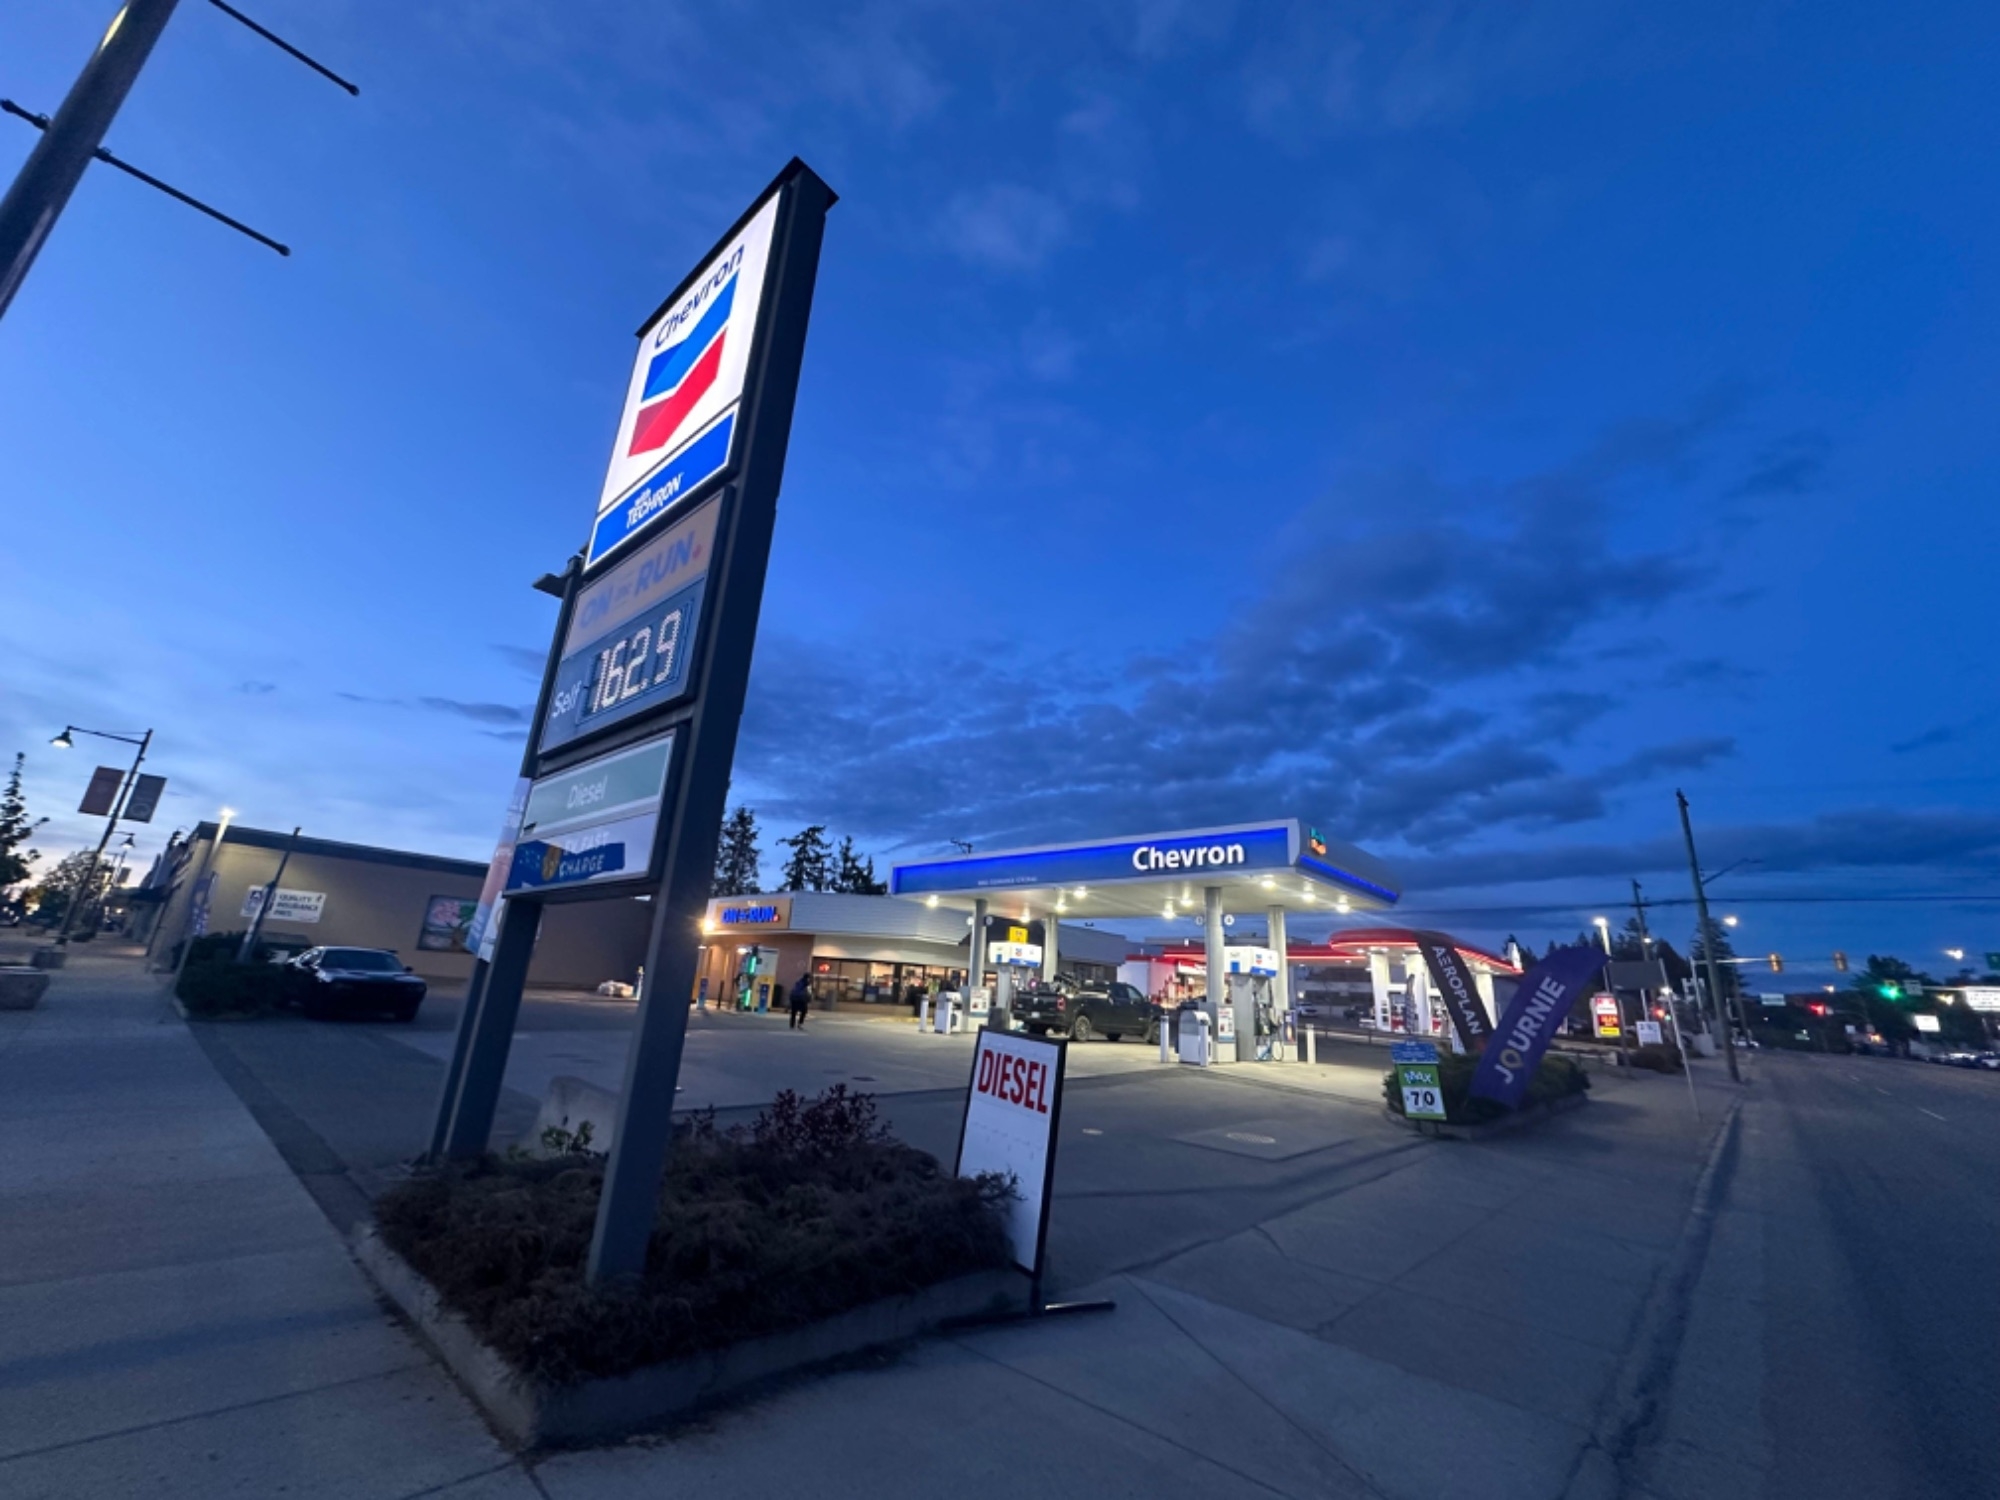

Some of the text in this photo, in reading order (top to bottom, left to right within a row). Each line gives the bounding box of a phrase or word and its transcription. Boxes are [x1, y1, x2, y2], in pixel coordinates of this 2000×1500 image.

[655, 244, 744, 349] Chevron
[626, 474, 682, 529] TECHRON
[551, 680, 582, 718] Self
[567, 774, 608, 810] Diesel
[1132, 843, 1245, 871] Chevron
[1432, 946, 1483, 1036] AEROPLAN
[1495, 976, 1567, 1085] JOURNIE
[977, 1049, 1048, 1114] DIESEL
